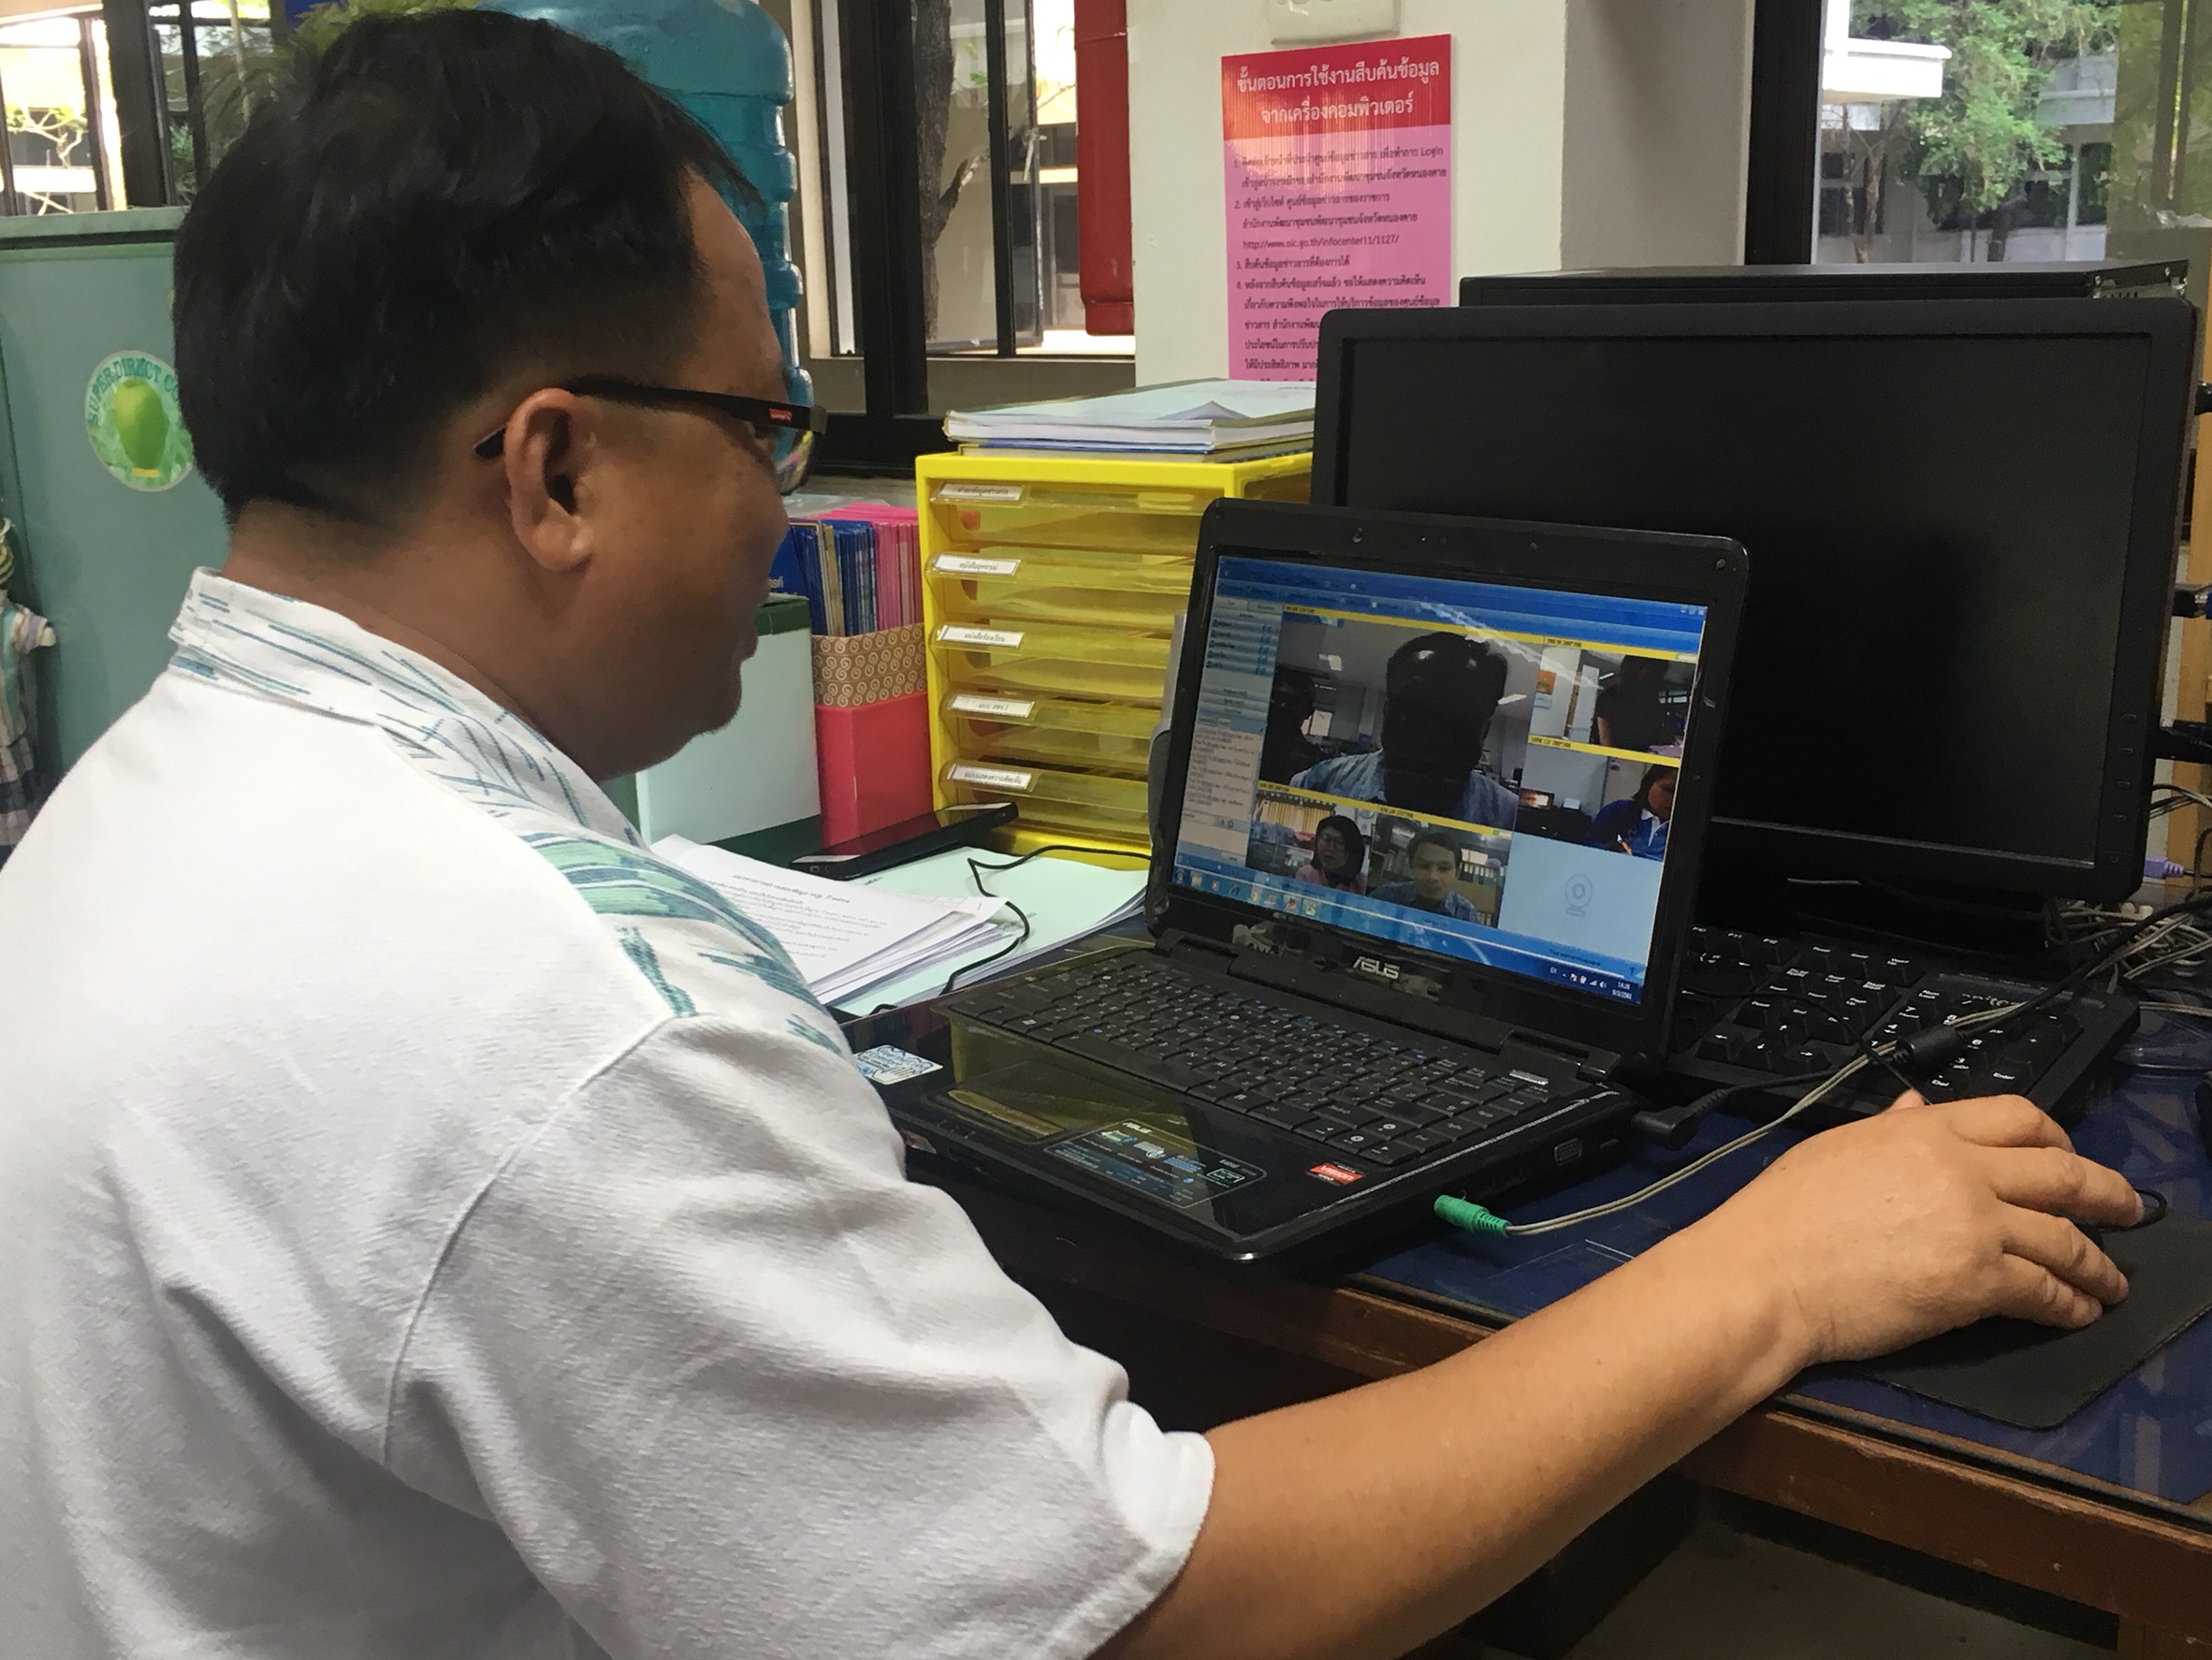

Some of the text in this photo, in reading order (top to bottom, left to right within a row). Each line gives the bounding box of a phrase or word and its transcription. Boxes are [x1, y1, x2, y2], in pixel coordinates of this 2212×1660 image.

[1237, 57, 1440, 92] ขั้นตอนการใช้งานสืบค้นข้อมูล
[1261, 91, 1414, 124] จากเครื่องคอมพิวเตอร์
[1420, 146, 1444, 158] Login
[89, 367, 116, 426] SUPER
[112, 357, 162, 383] DIRECT
[1353, 955, 1401, 980] ASUS
